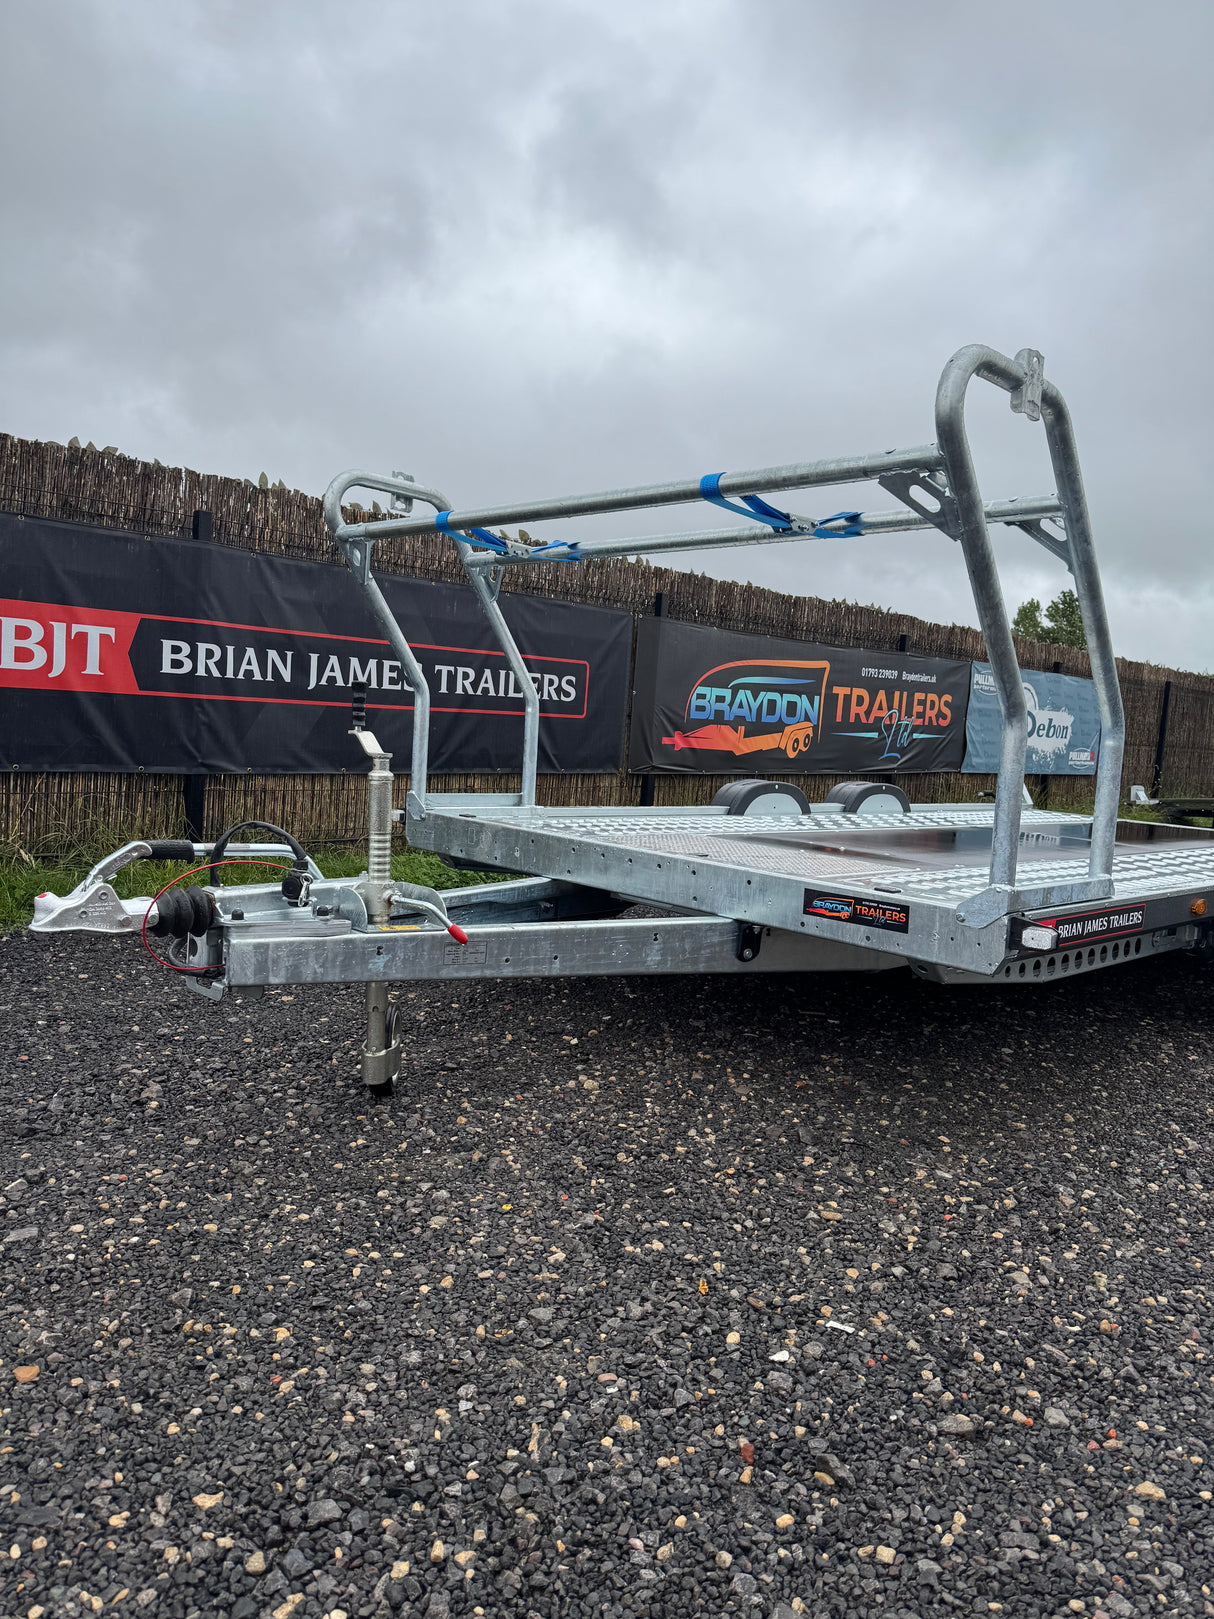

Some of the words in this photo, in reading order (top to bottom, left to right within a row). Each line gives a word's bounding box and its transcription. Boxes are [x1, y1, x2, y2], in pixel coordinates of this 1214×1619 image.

[0, 616, 116, 678] BJT
[160, 638, 294, 683] BRIAN
[862, 667, 878, 678] 01793
[690, 685, 820, 726] BRAYDON
[832, 686, 953, 727] TRAILERS
[878, 709, 914, 761] Ltd
[812, 900, 852, 914] BRAYDON
[855, 905, 907, 923] TRAILERS
[1058, 921, 1083, 938] BRIAN
[1083, 916, 1108, 936] JAMES
[1109, 911, 1143, 929] TRAILERS
